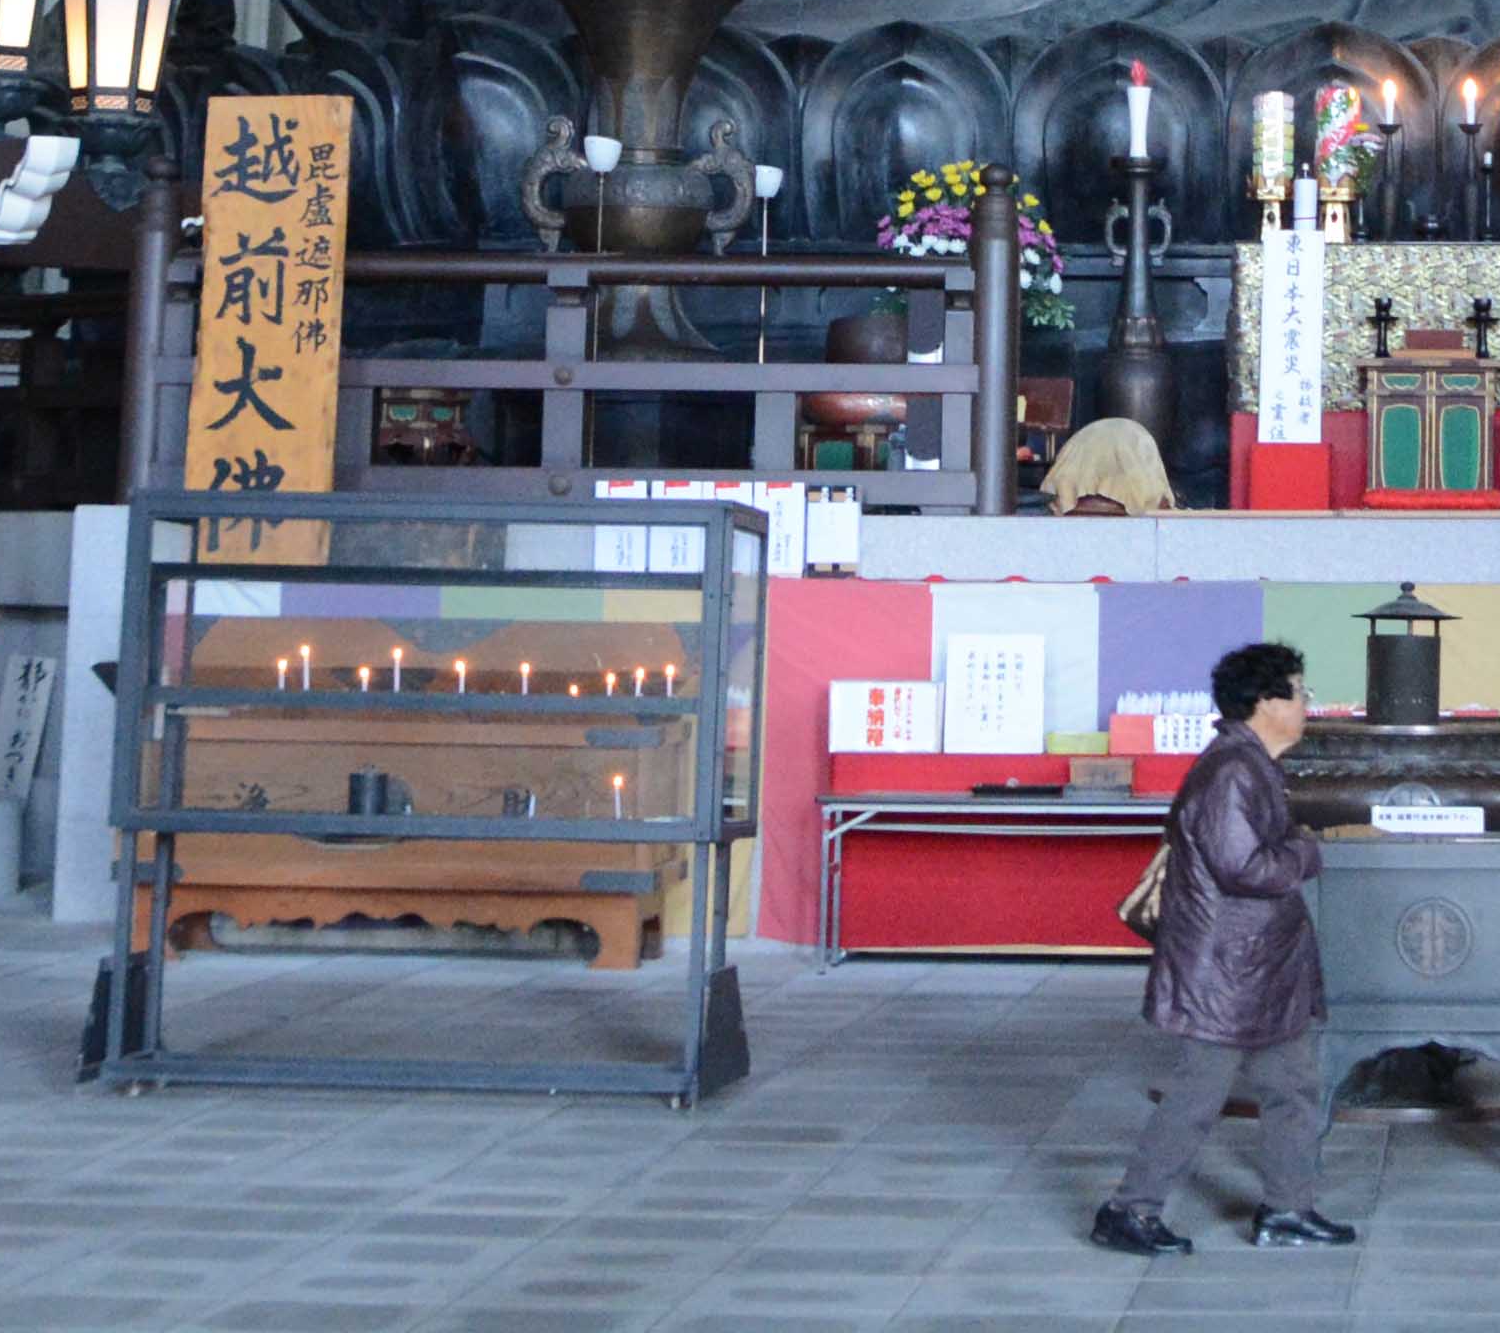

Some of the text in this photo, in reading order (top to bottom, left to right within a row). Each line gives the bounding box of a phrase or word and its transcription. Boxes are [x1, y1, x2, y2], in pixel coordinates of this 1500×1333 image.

[204, 112, 300, 553] 越前大佛
[293, 142, 340, 355] 毘盧遮那佛
[1283, 233, 1304, 375] 東日本大震災
